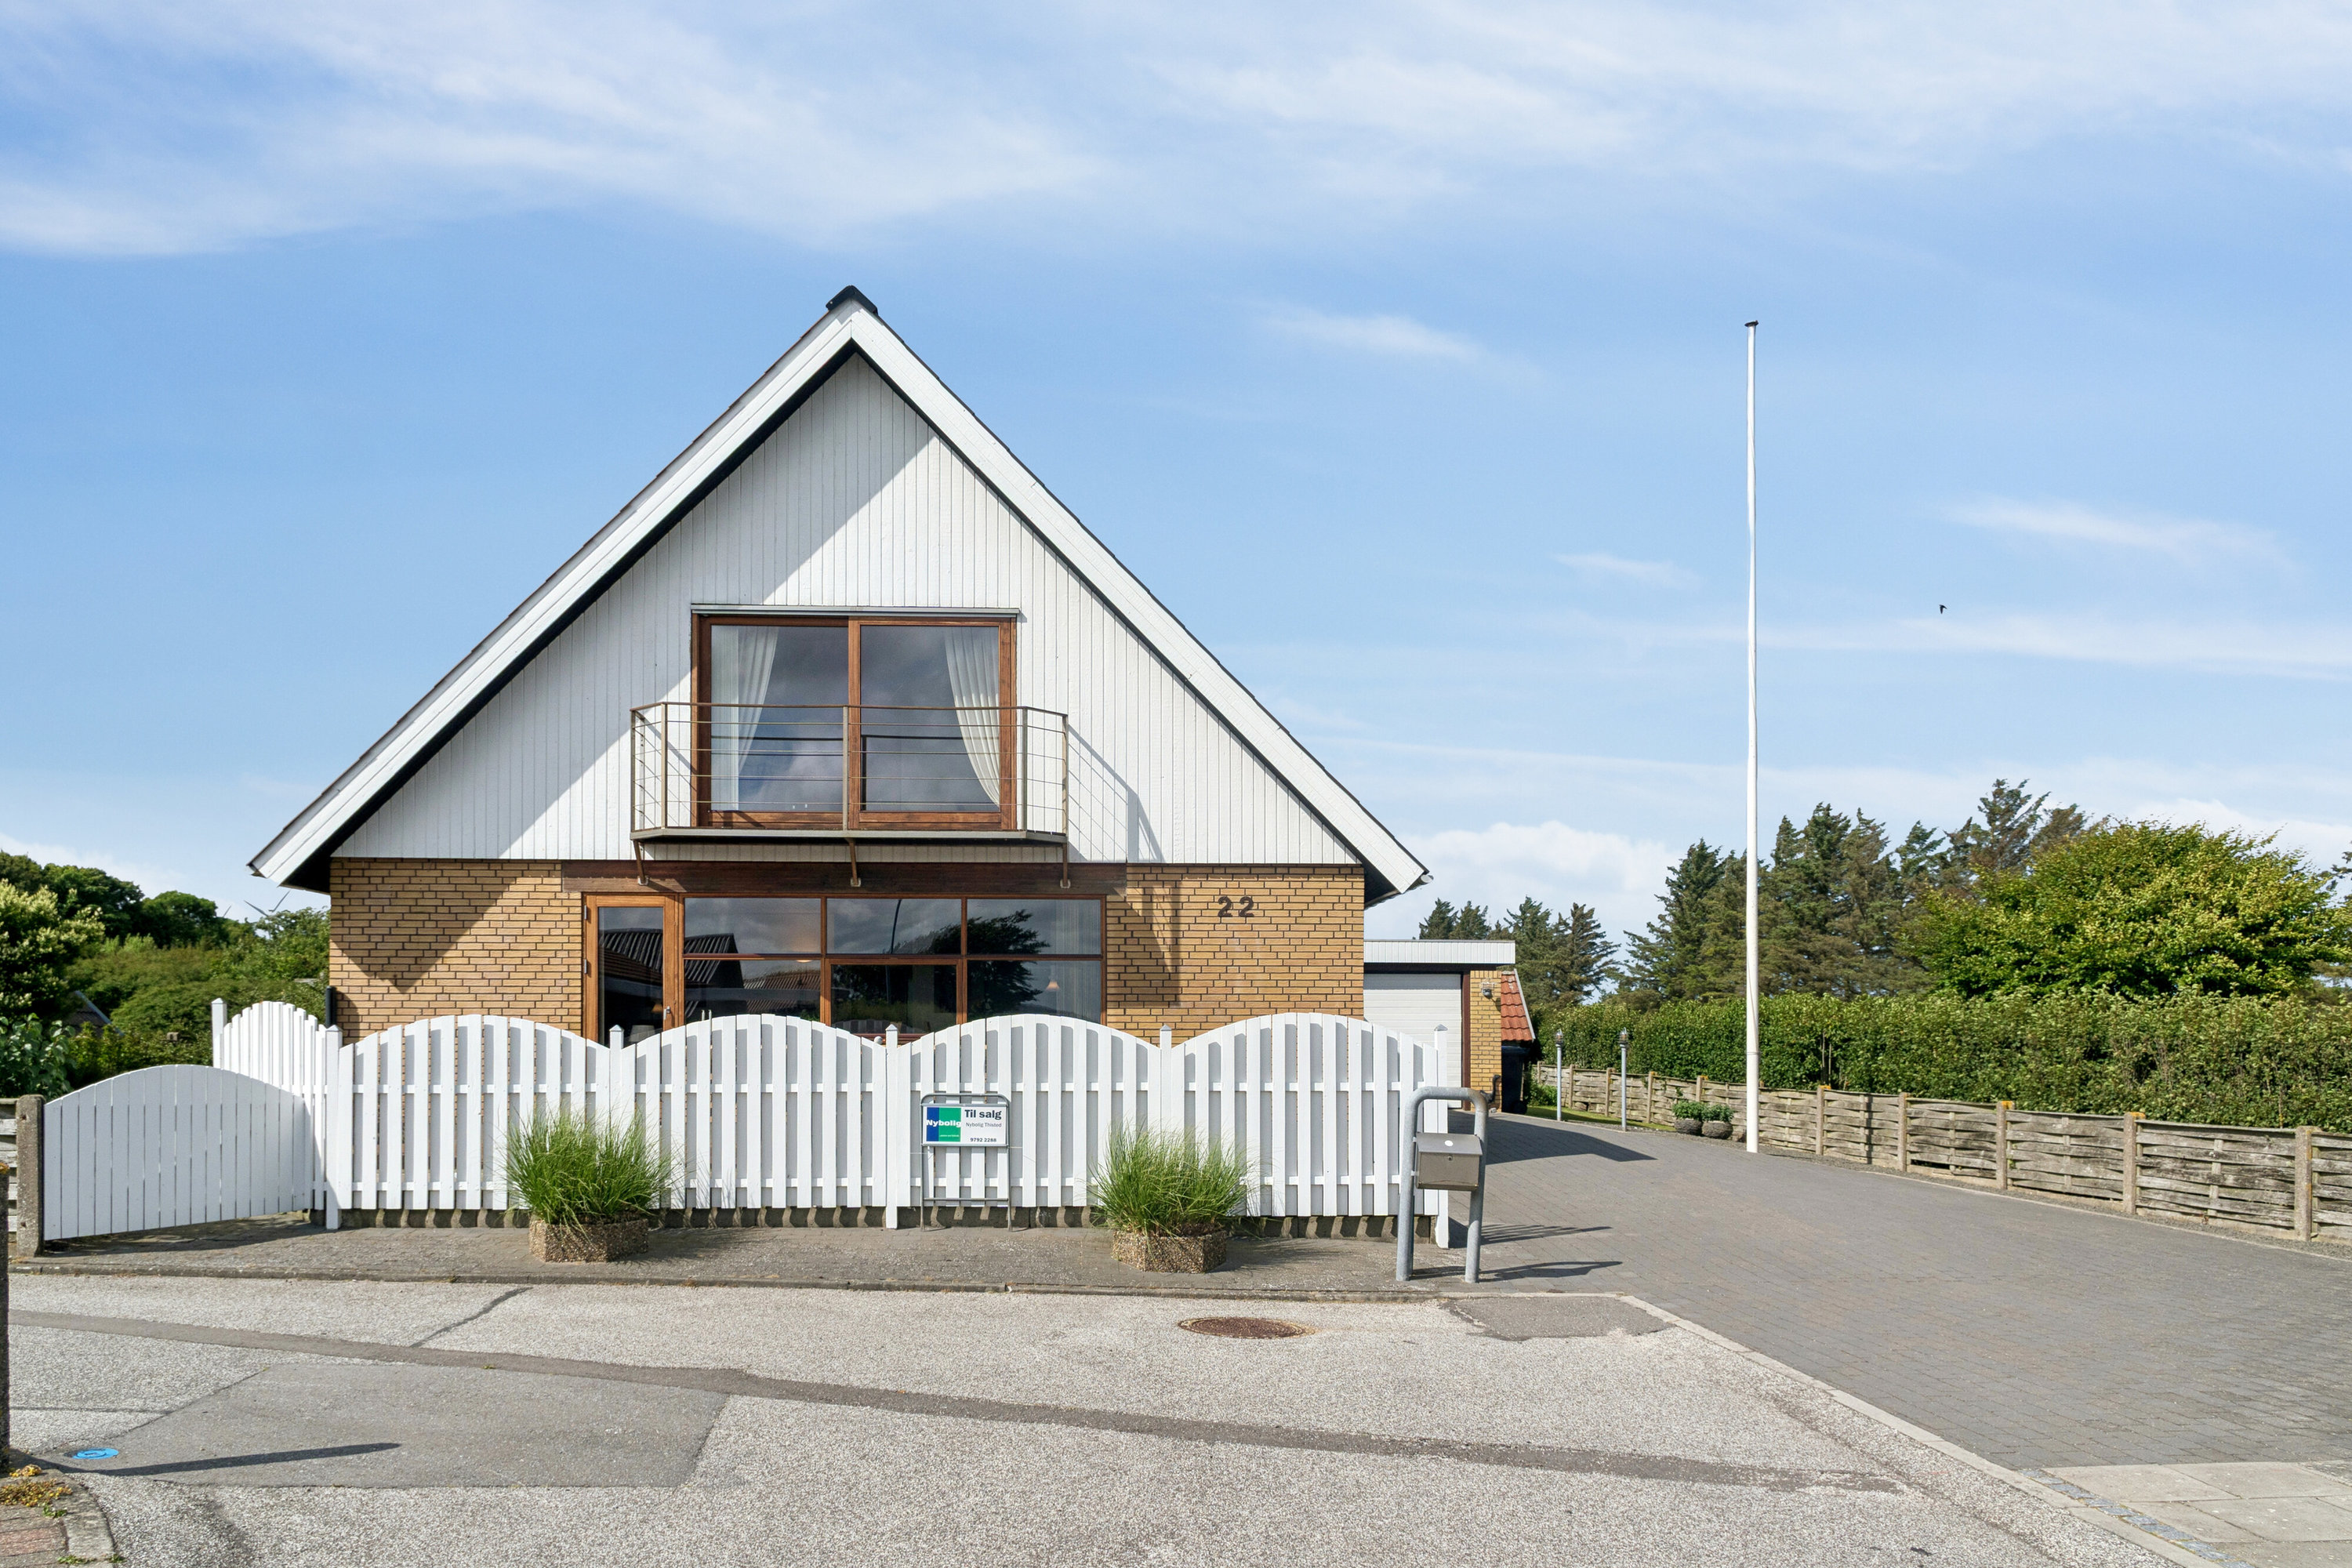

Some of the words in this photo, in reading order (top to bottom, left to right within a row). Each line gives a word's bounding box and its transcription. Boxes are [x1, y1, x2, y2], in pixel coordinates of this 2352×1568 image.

[1218, 896, 1254, 917] 22
[964, 1109, 976, 1118] Til
[979, 1110, 1002, 1120] salg
[926, 1120, 961, 1128] Nybolig
